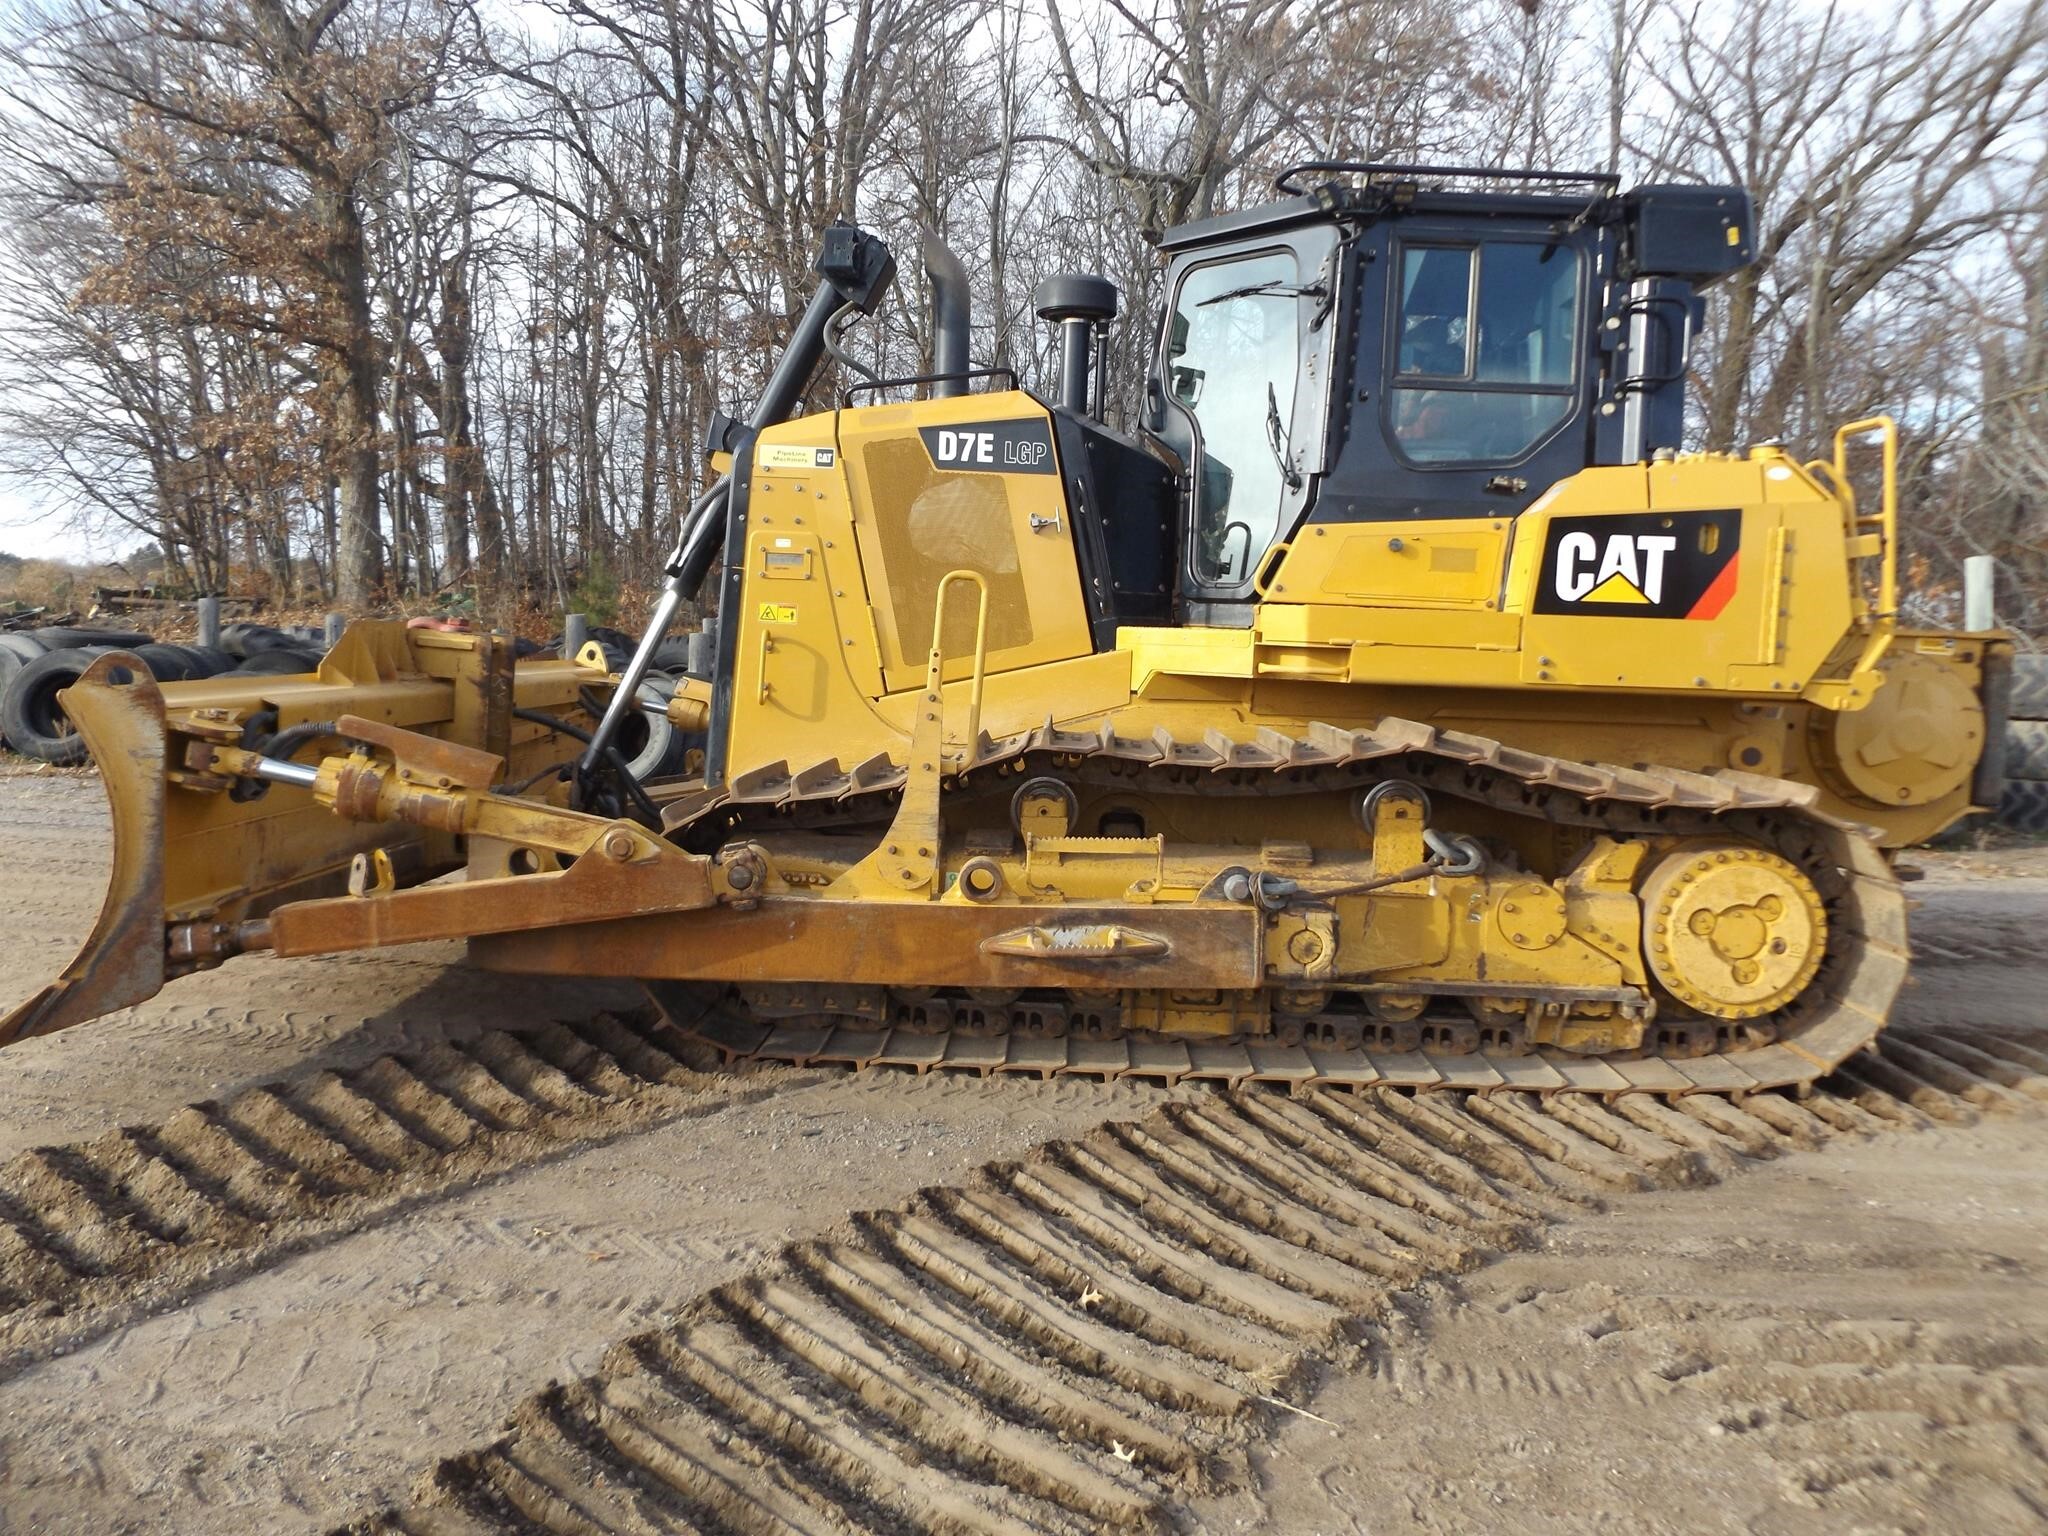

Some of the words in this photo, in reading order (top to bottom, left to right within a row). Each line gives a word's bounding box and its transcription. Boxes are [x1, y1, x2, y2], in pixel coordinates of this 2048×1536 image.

[817, 453, 833, 463] CAT
[938, 430, 994, 463] D7E
[1004, 441, 1047, 465] LGP
[1555, 531, 1676, 605] CAT
